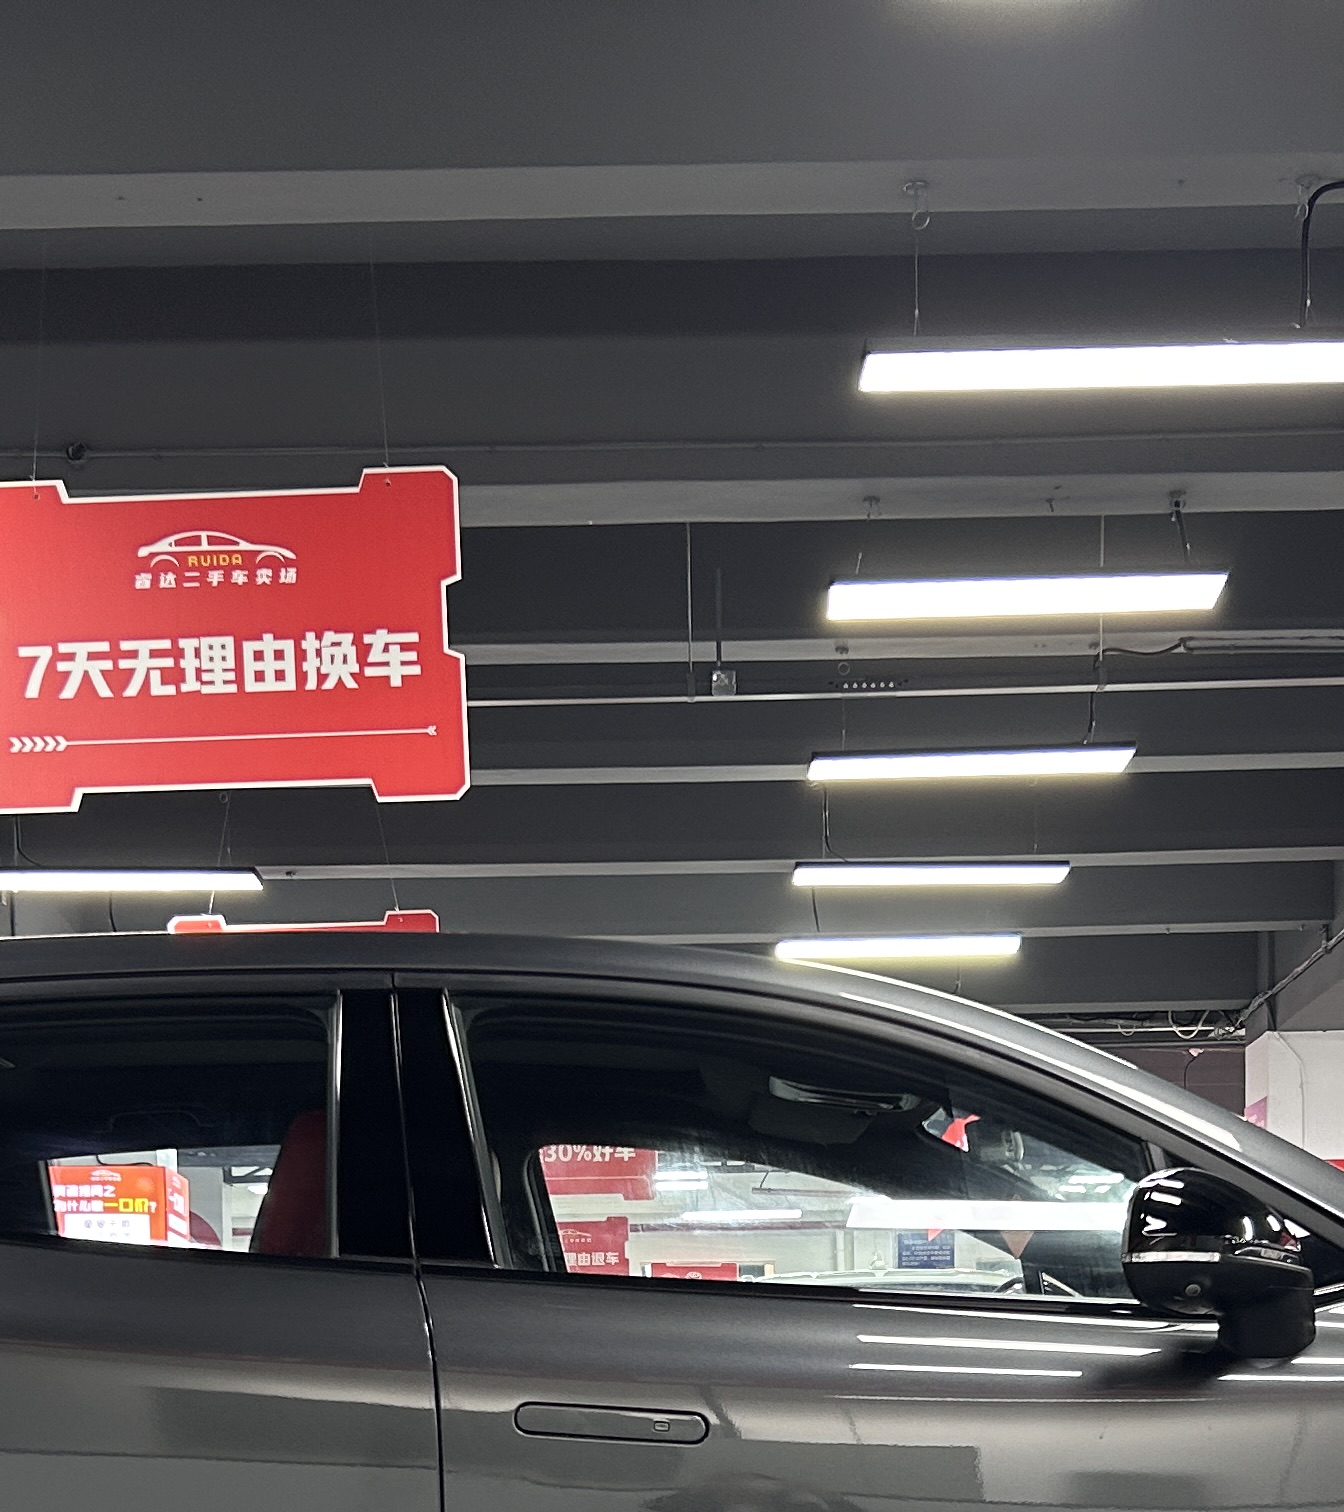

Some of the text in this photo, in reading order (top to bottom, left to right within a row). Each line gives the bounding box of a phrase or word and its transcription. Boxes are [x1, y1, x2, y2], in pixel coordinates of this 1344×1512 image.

[187, 553, 243, 568] RUIDA
[17, 629, 422, 699] 7天无理由换车
